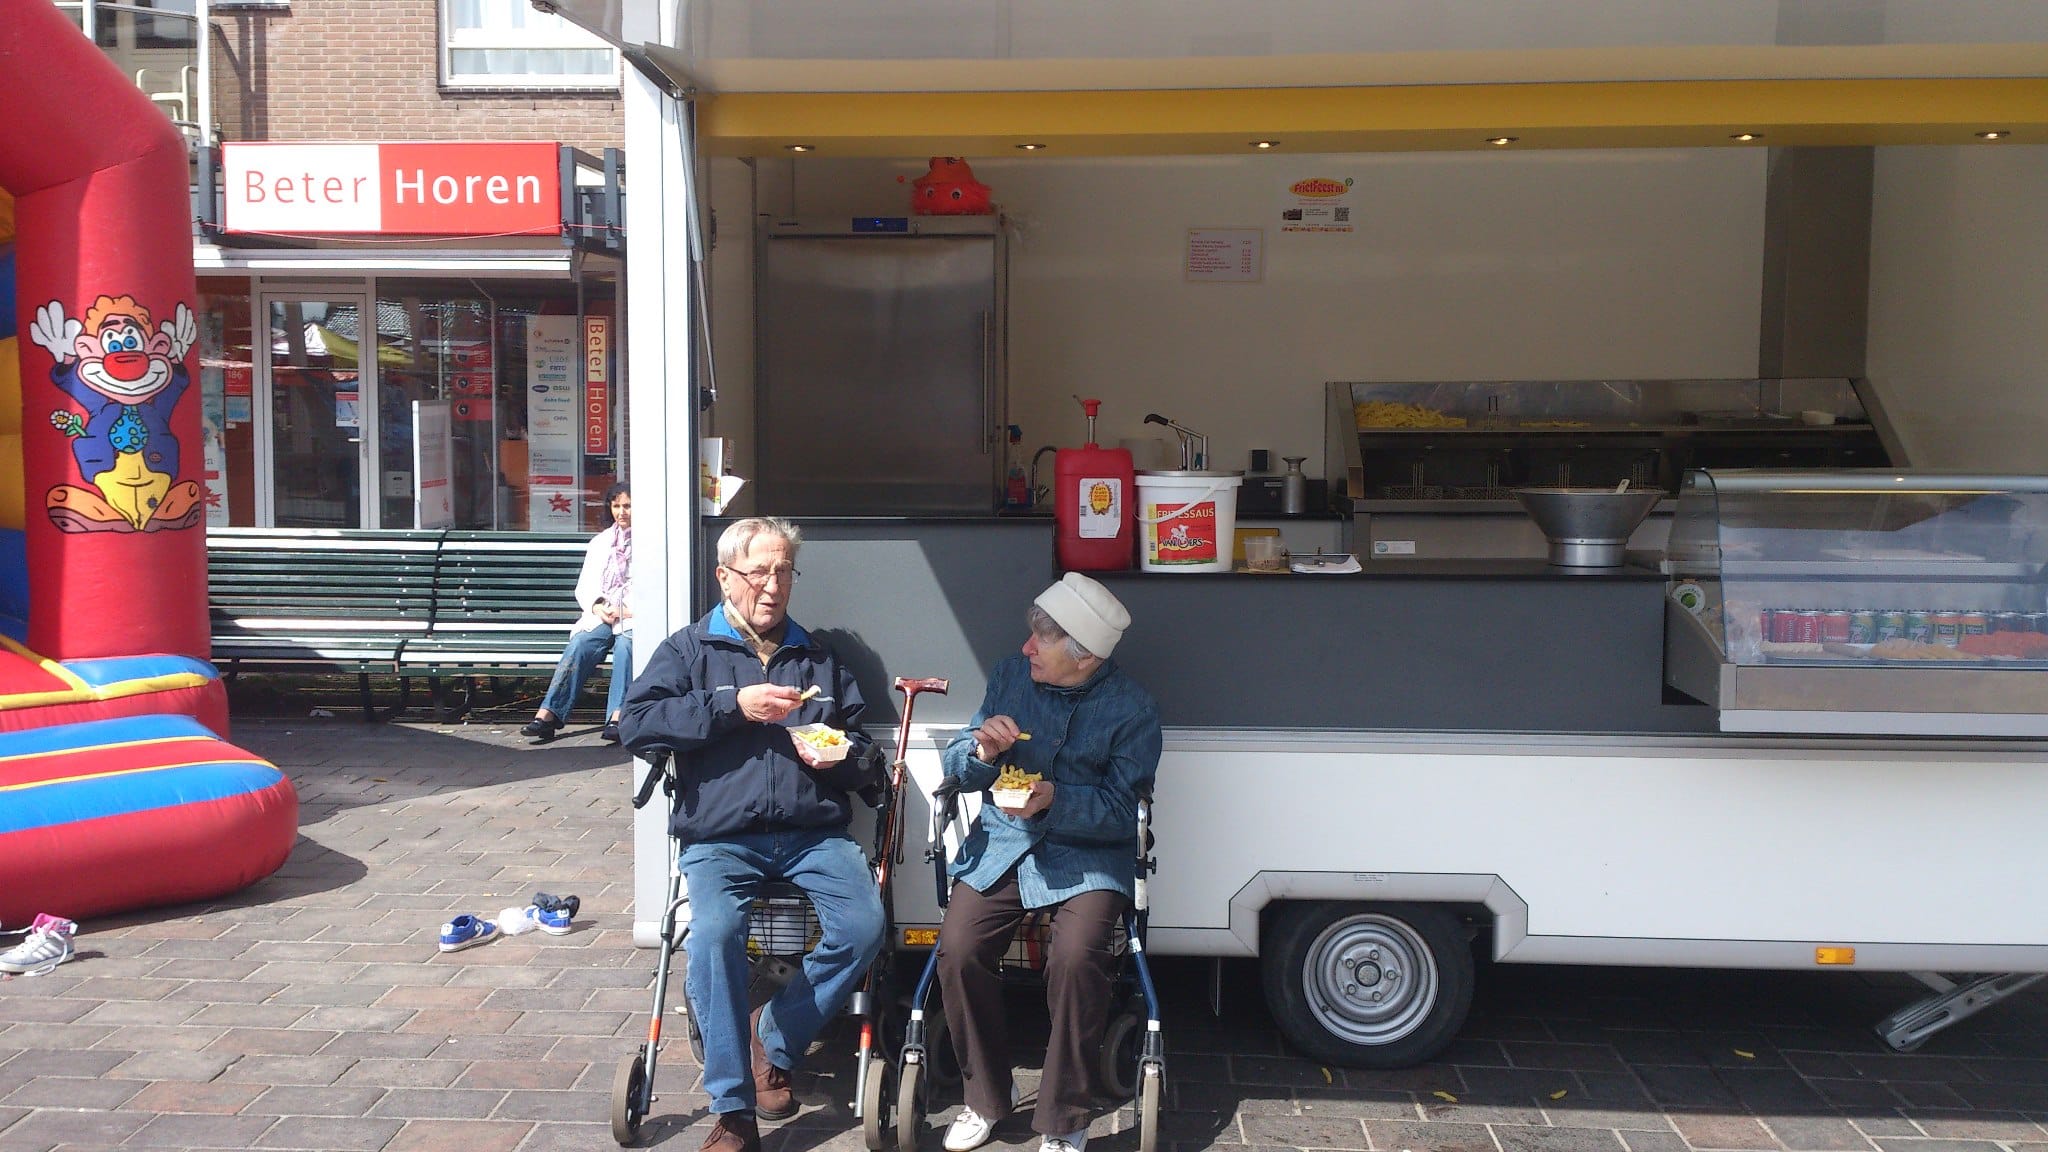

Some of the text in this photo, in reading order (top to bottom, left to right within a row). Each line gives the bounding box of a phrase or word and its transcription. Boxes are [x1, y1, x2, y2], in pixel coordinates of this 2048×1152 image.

[246, 169, 540, 204] Beter Horen
[590, 324, 604, 447] Beter Horen
